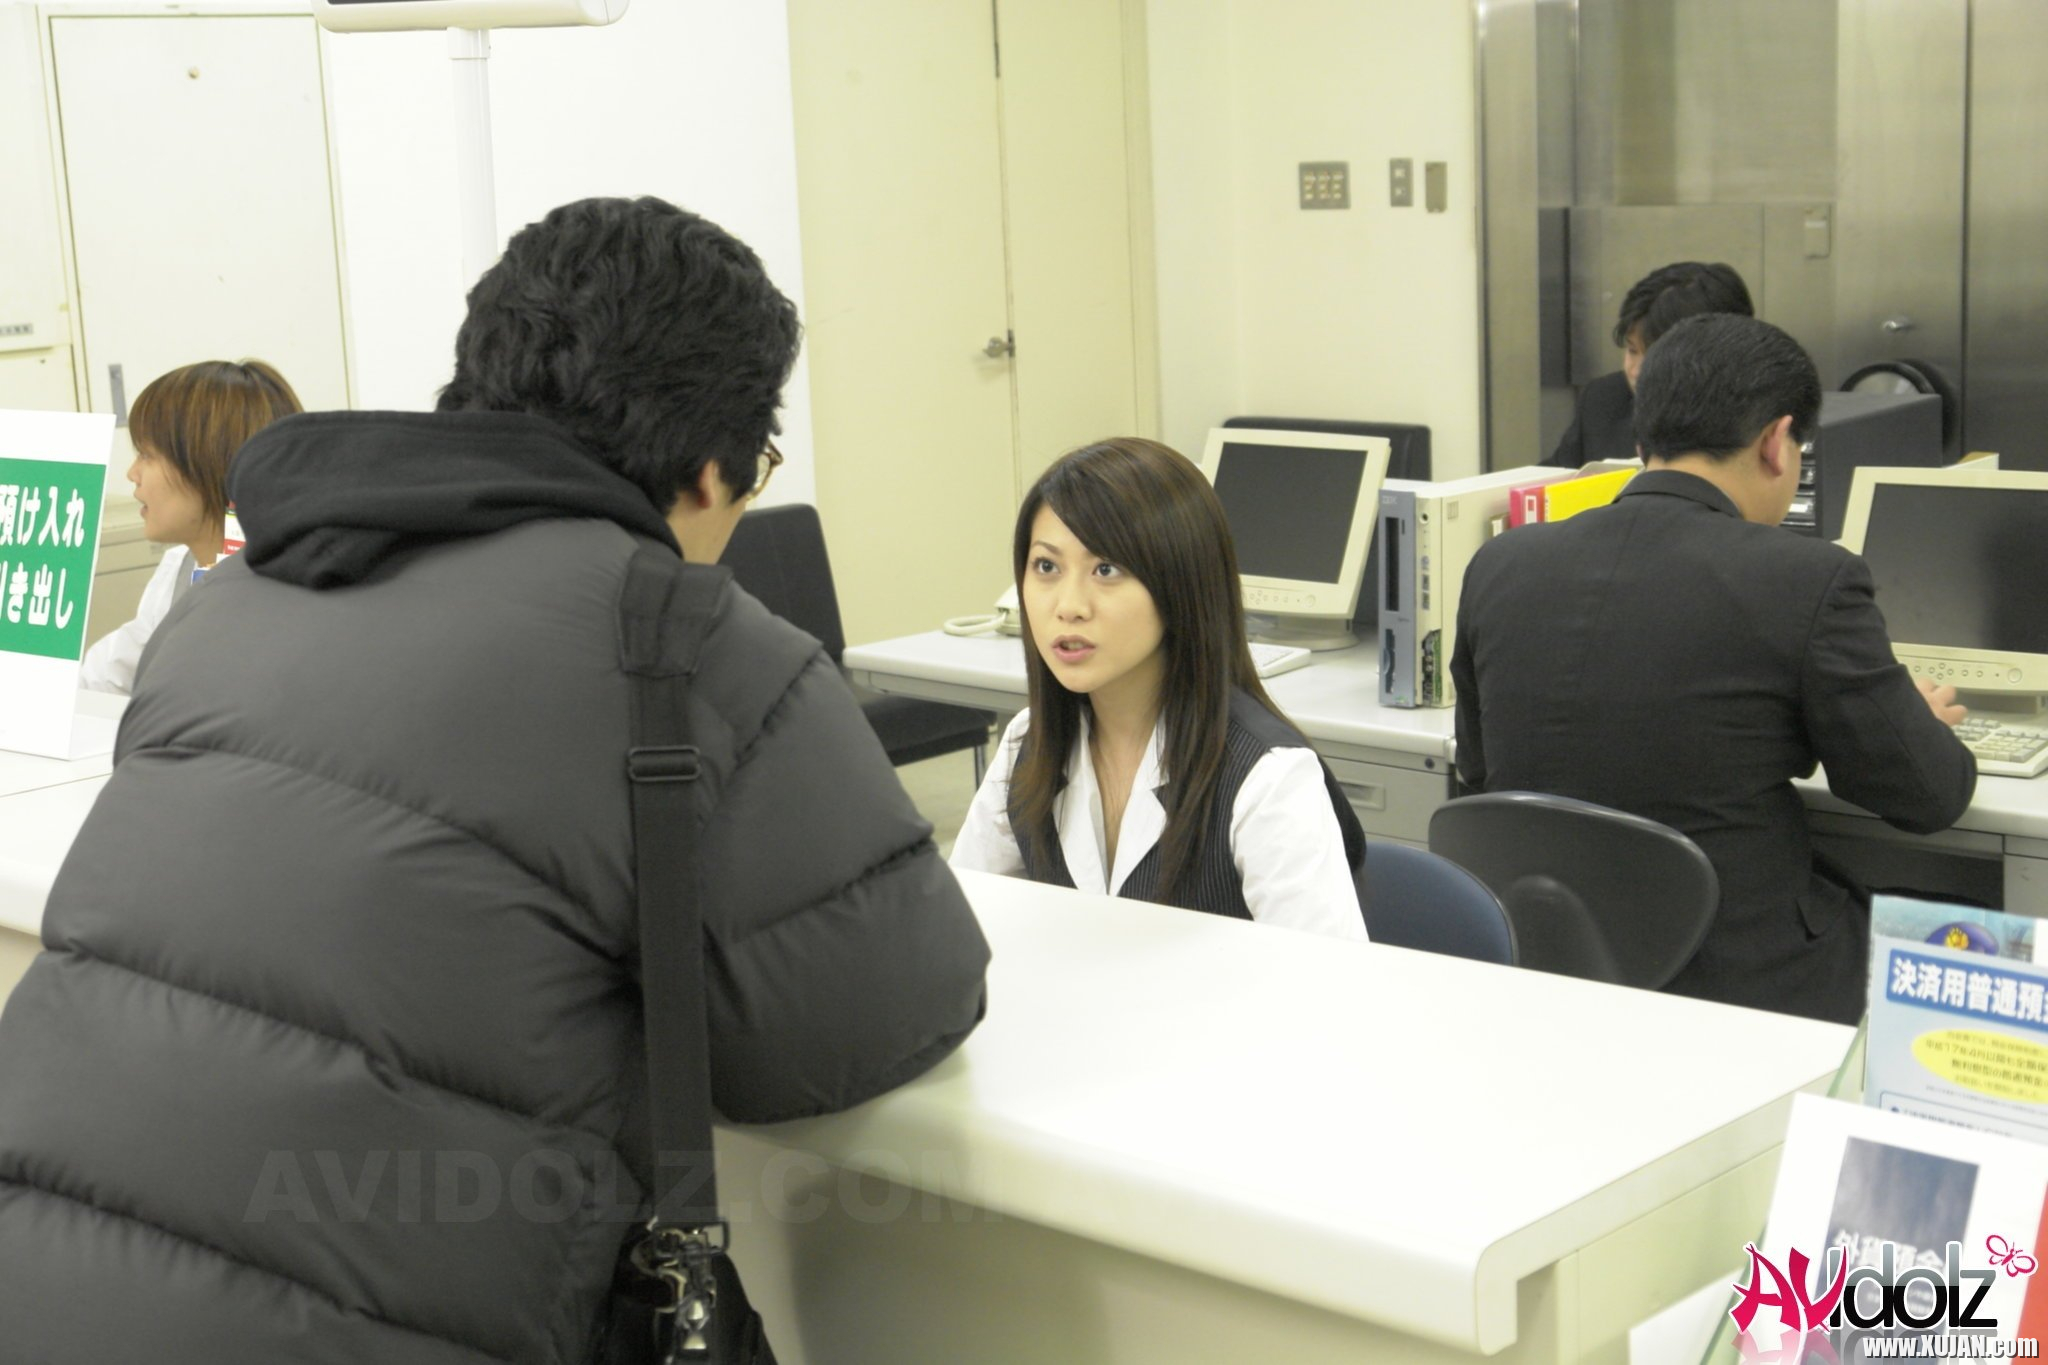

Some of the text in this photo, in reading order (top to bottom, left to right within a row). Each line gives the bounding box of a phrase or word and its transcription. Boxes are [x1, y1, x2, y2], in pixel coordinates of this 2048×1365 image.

[0, 484, 85, 548] 預け入れ
[1891, 957, 2048, 1024] 決済用普通預
